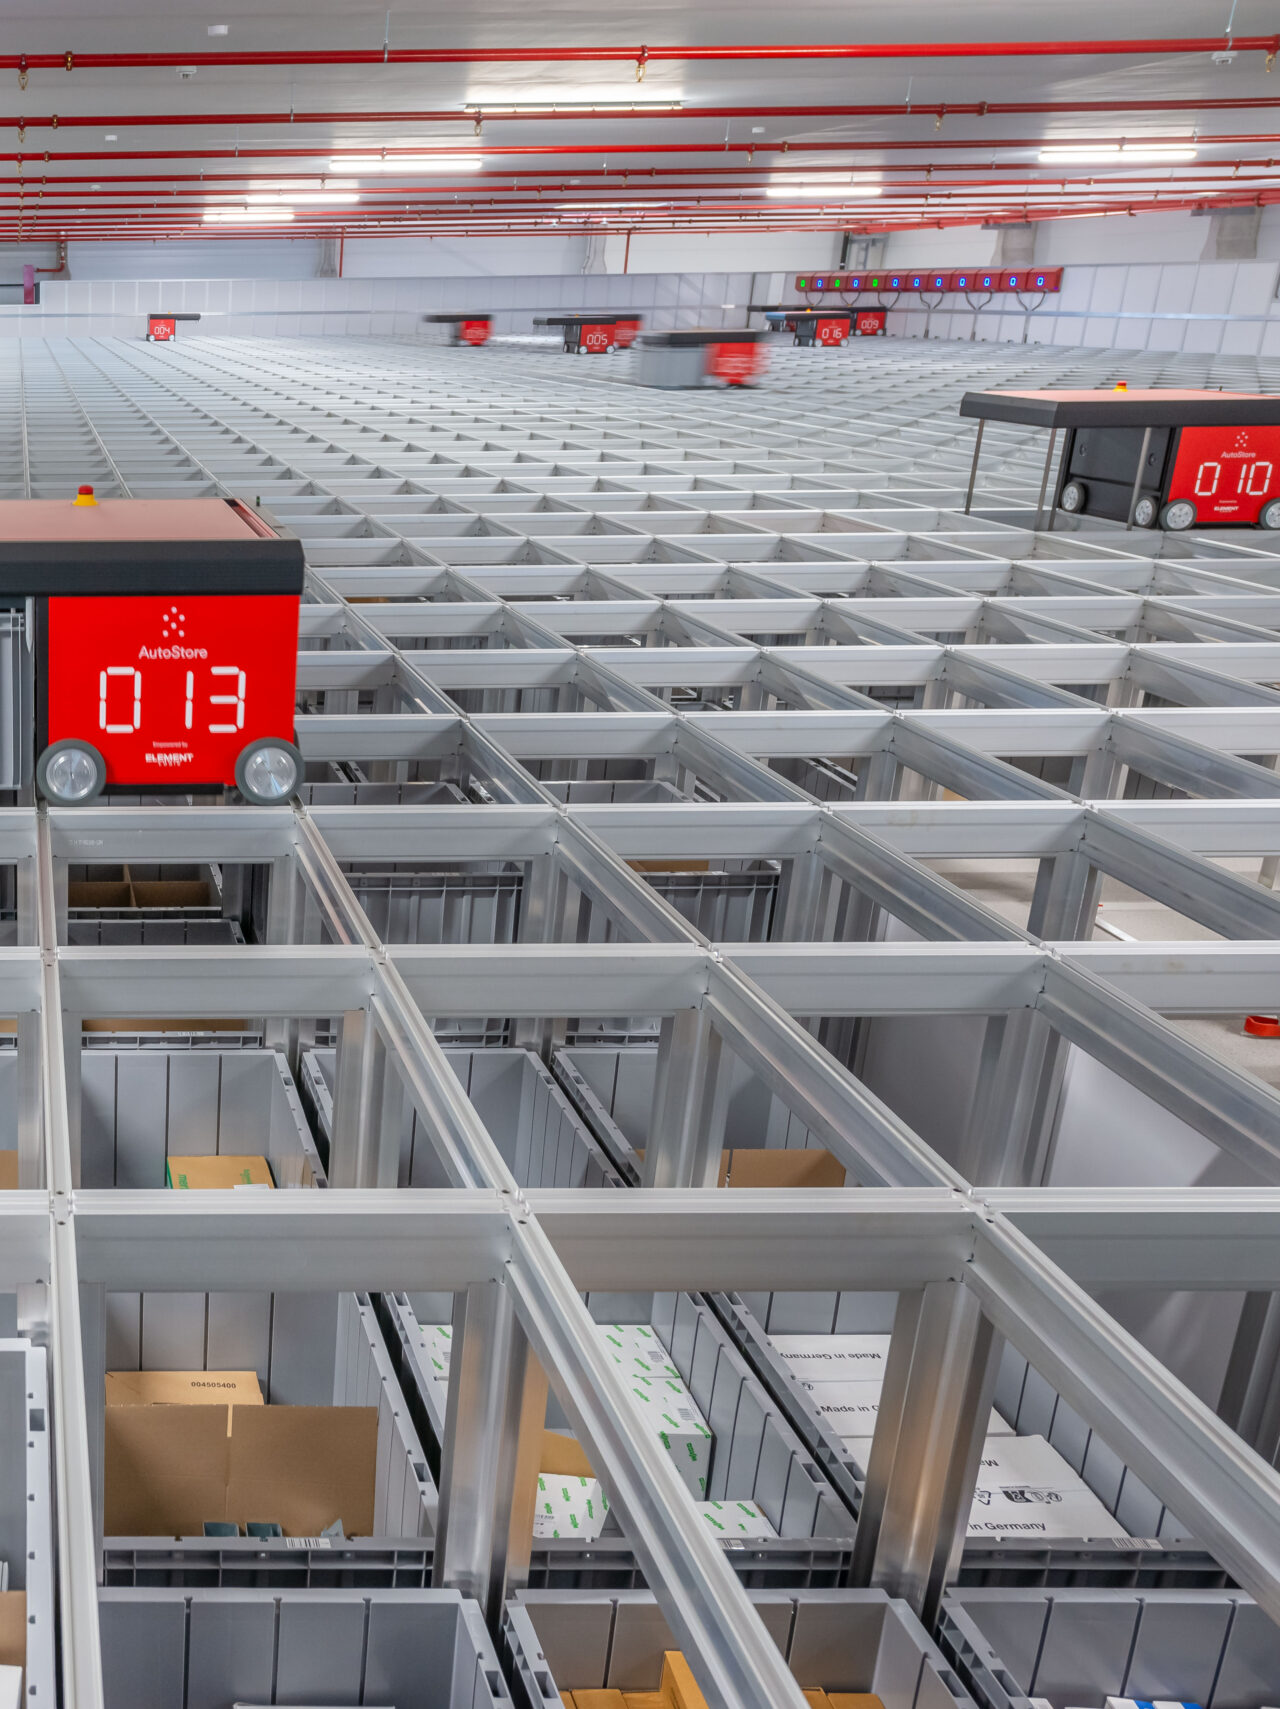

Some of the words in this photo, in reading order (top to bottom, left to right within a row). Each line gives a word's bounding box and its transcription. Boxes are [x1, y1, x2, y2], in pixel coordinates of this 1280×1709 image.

[154, 326, 171, 335] 004
[586, 334, 608, 345] 005
[1221, 451, 1256, 459] AutoStore
[1194, 461, 1273, 496] 010
[138, 645, 208, 660] AutoStore
[99, 666, 247, 734] 013
[145, 753, 194, 763] ELEMENT
[820, 1405, 855, 1413] Made
[969, 1522, 983, 1531] in
[984, 1522, 1046, 1532] Germany
